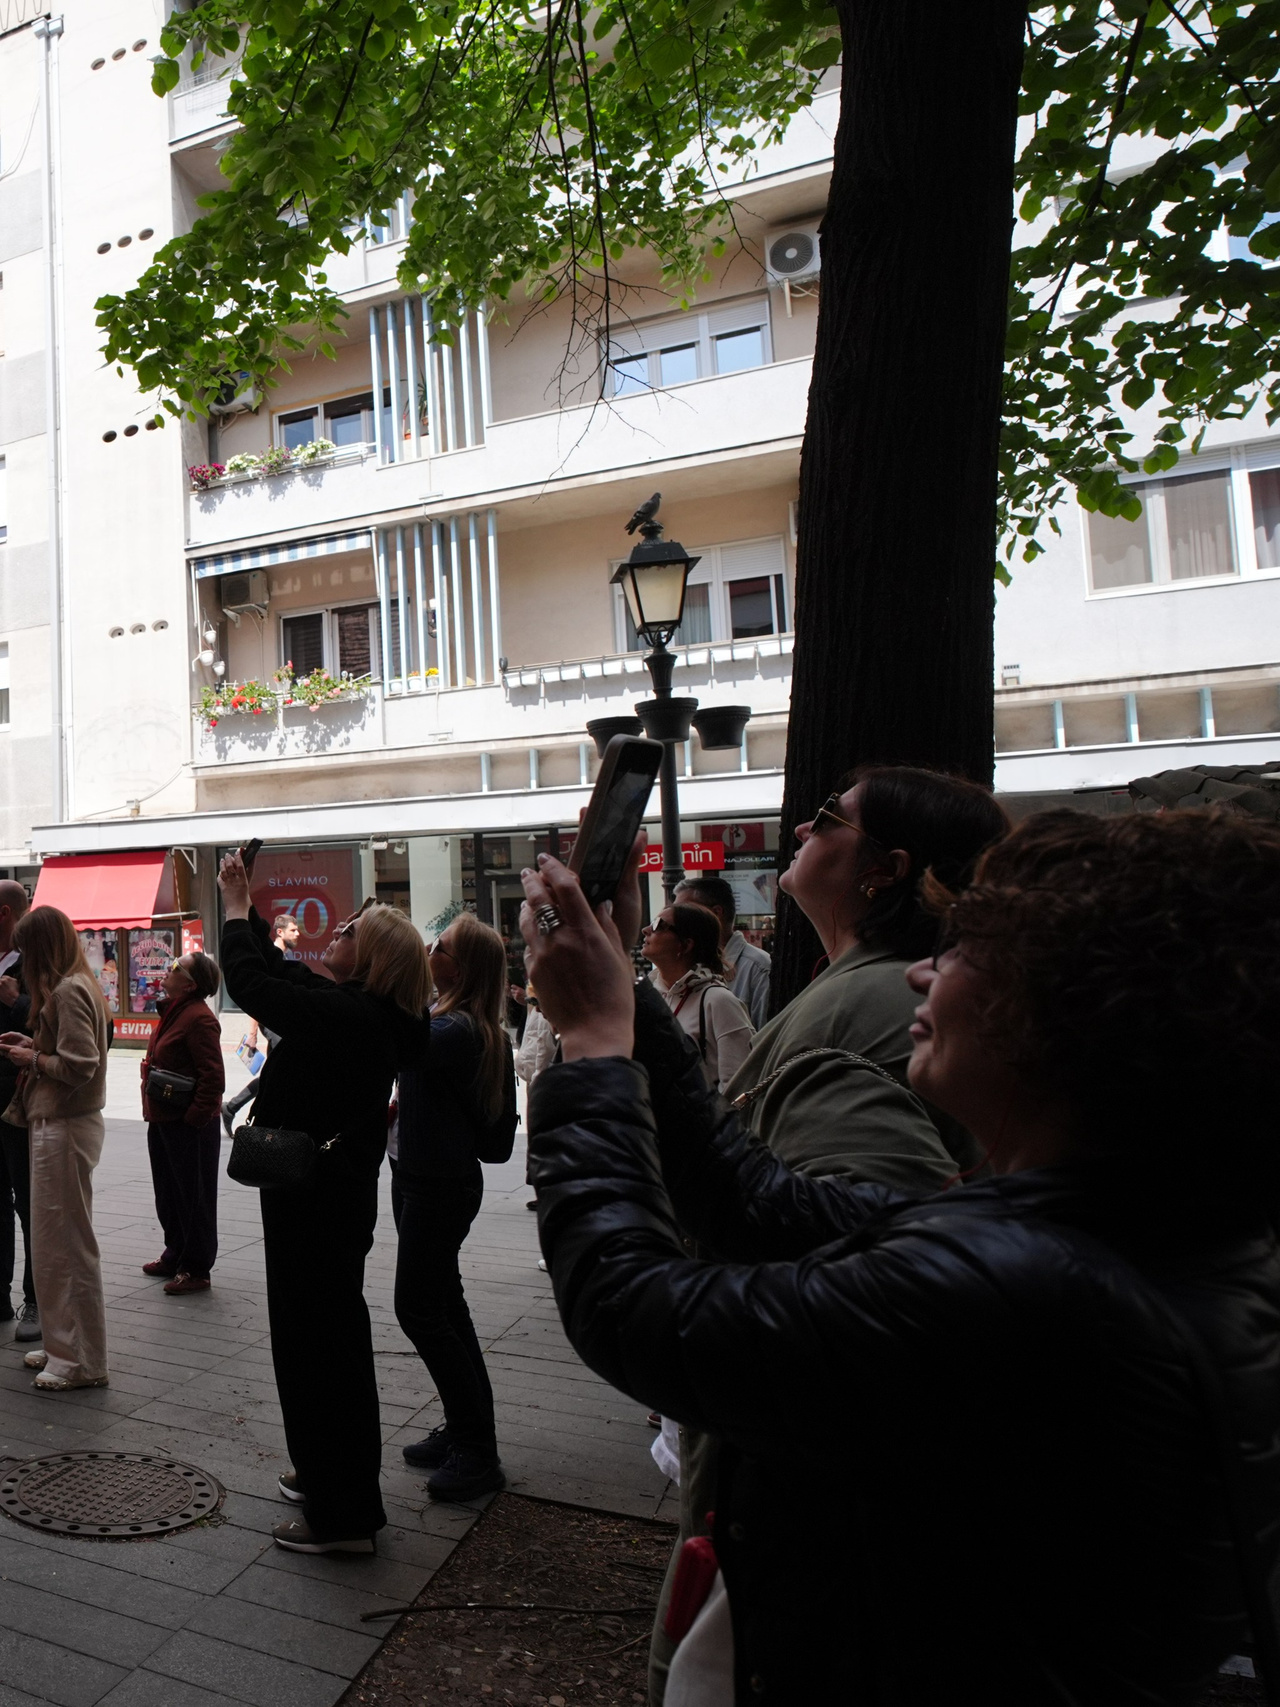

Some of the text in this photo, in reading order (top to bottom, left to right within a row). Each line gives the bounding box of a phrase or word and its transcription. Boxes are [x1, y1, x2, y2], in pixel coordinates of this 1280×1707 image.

[638, 844, 712, 868] jamin
[268, 876, 328, 887] SLAVIMO
[293, 950, 327, 961] DINA
[121, 1022, 153, 1035] EVITA
